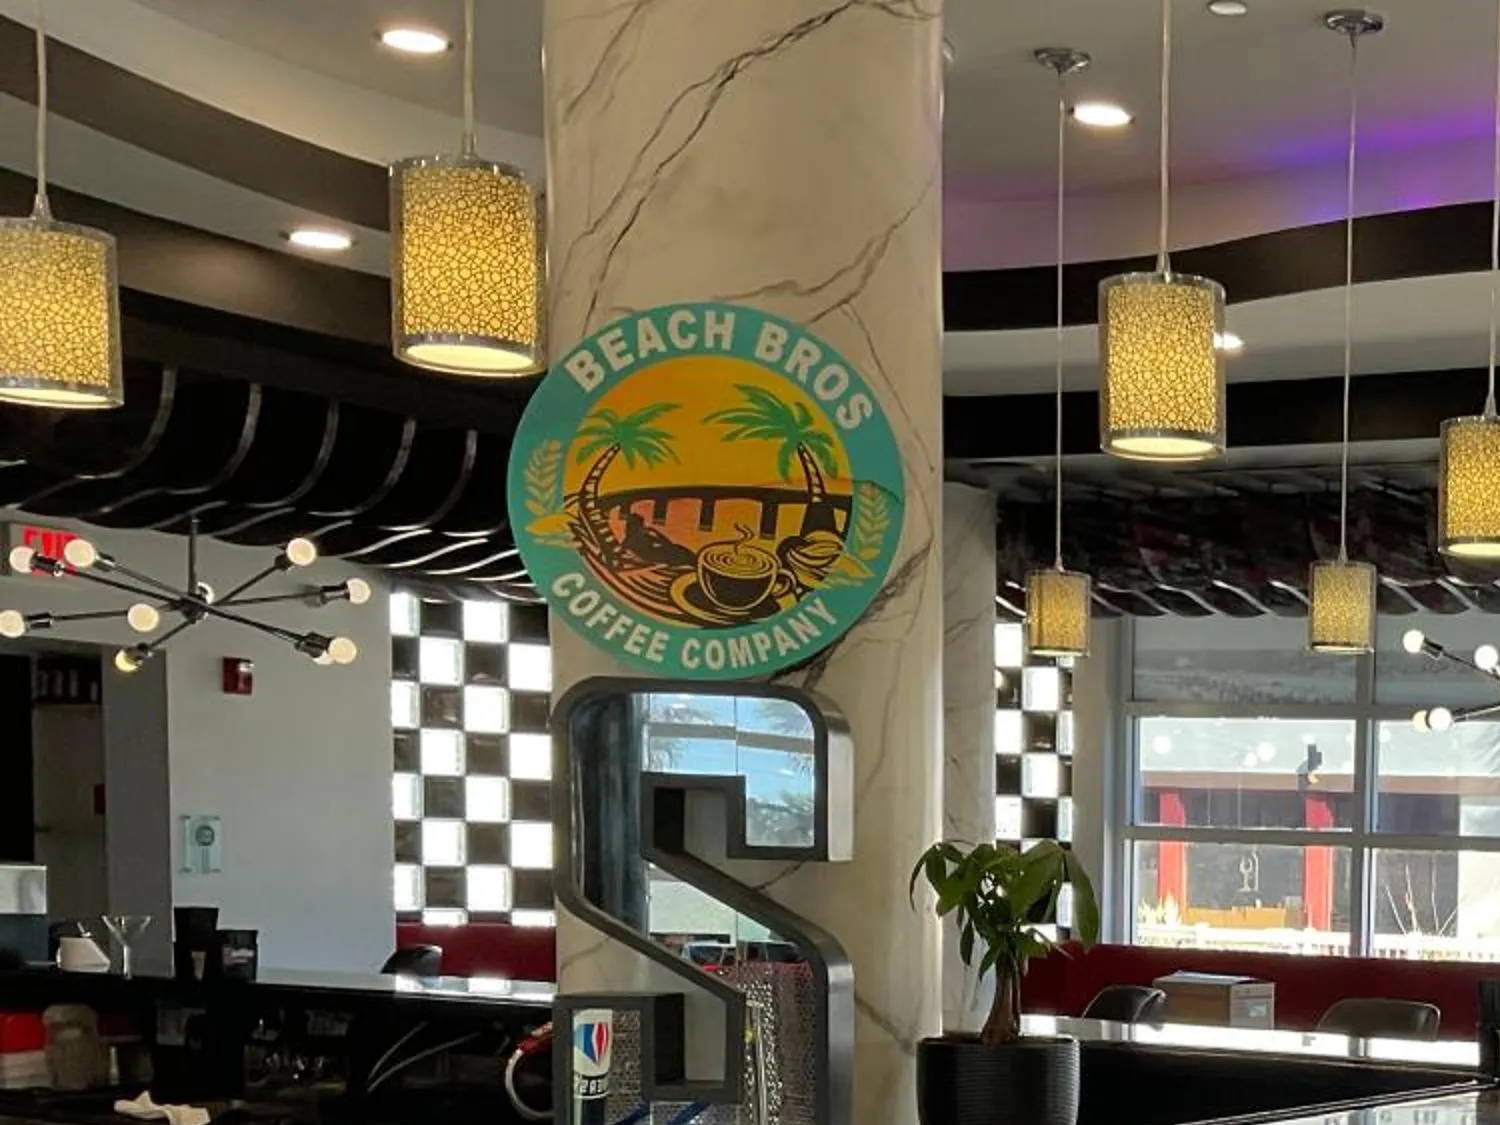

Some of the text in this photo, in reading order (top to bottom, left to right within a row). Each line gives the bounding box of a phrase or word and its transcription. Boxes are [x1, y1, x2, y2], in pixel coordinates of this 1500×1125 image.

[565, 310, 873, 430] BEACH BROS
[552, 572, 837, 671] COFFEE COMPANY
